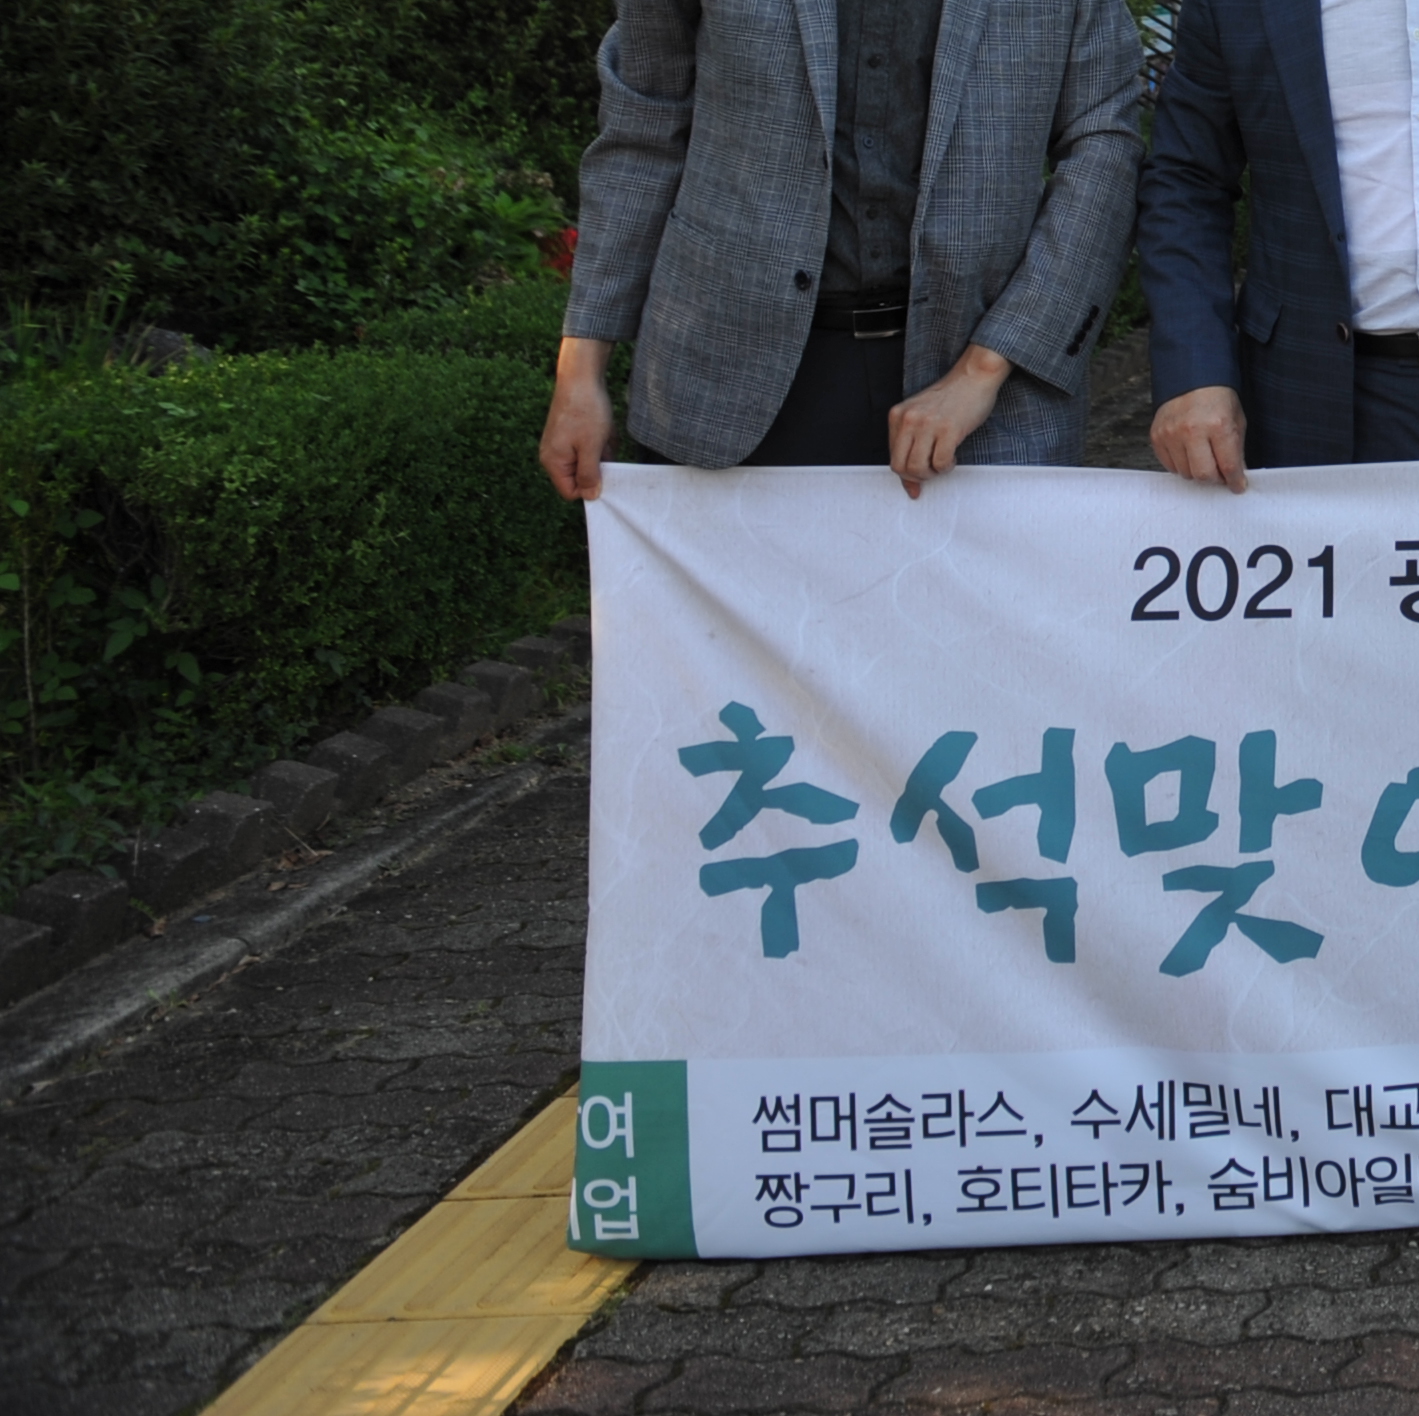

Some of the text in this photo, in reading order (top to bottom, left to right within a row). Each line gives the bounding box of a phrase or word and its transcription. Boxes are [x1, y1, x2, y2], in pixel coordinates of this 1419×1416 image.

[1131, 545, 1333, 621] 2021
[579, 1092, 634, 1158] 여
[753, 1090, 1042, 1152] 썸머솔라스,
[1071, 1080, 1299, 1142] 수세밀네,
[756, 1170, 931, 1227] 짱구리,
[957, 1160, 1184, 1217] 호티타카,
